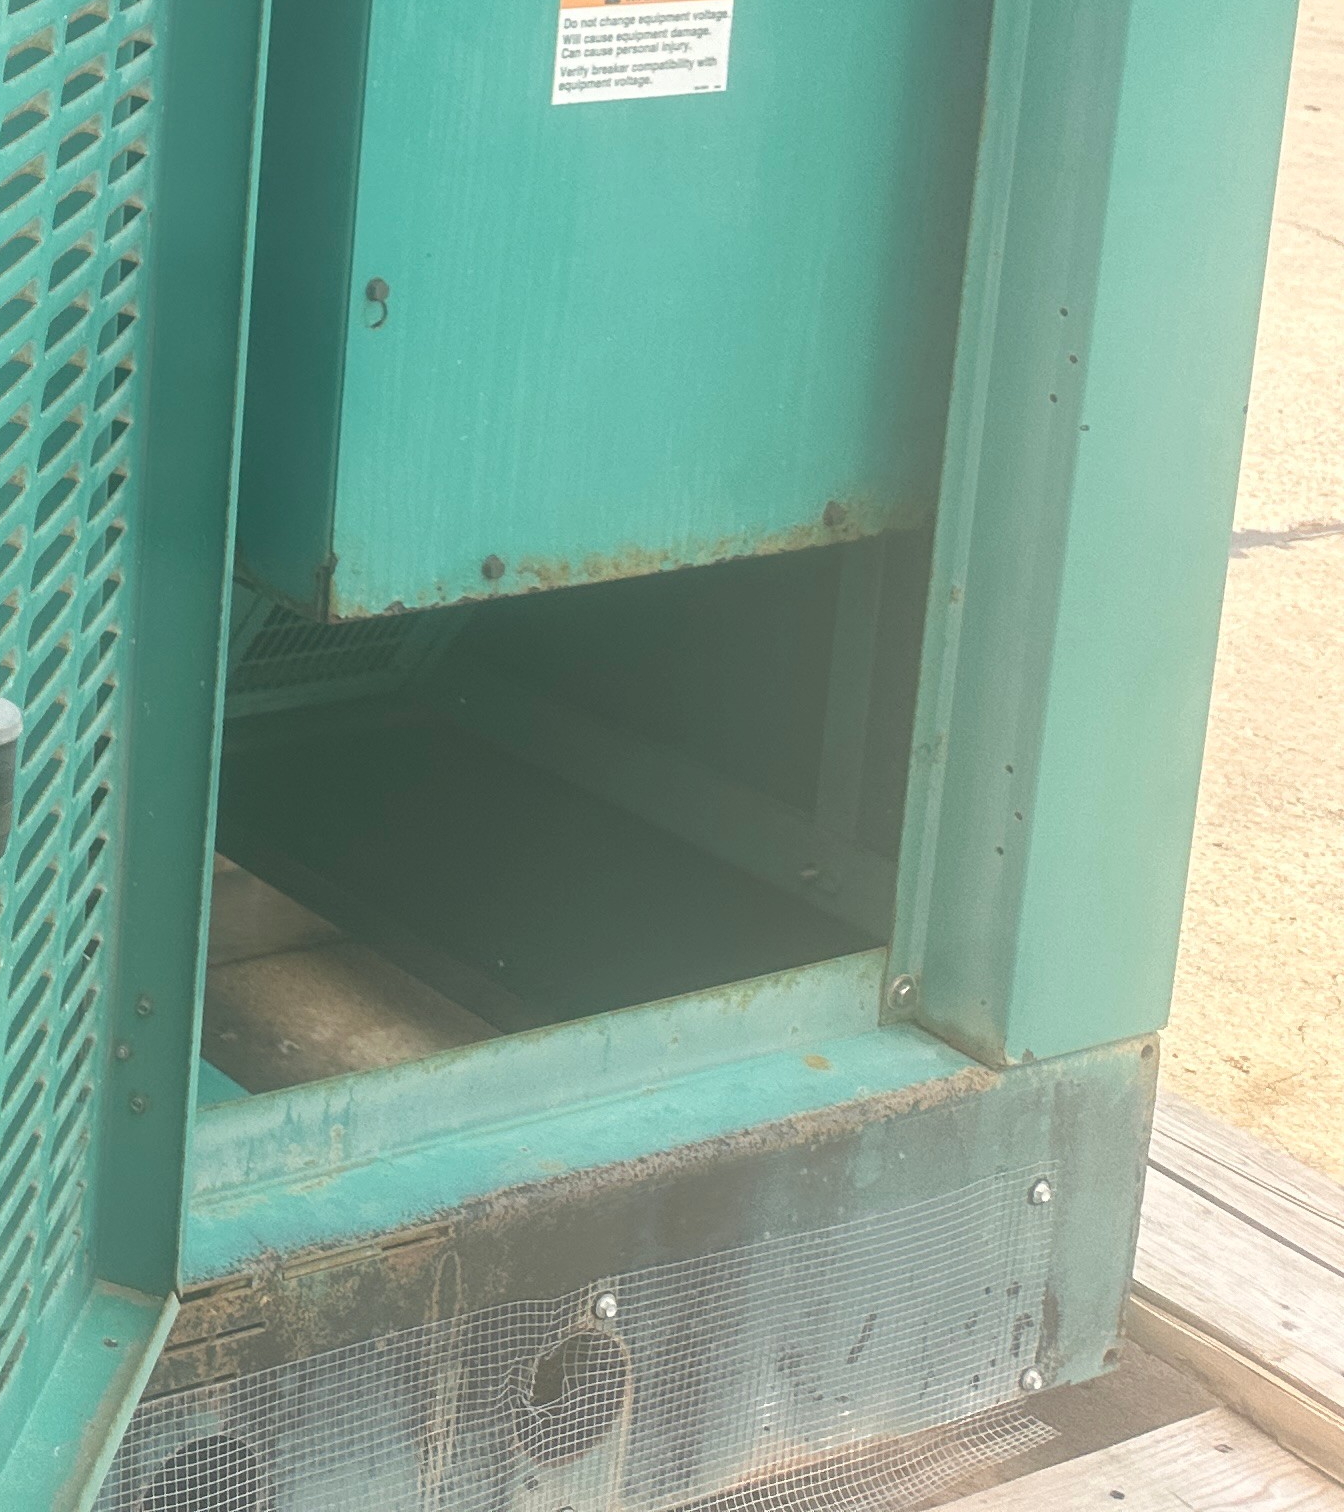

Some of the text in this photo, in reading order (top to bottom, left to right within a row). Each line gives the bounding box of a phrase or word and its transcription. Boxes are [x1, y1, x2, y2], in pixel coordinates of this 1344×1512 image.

[564, 18, 578, 29] Do
[581, 17, 597, 28] not
[600, 16, 636, 28] change
[638, 12, 691, 26] equipment
[563, 34, 582, 44] Will
[584, 34, 613, 44] cause
[616, 29, 669, 42] equipment
[562, 48, 581, 58] Can
[584, 48, 613, 57] cause
[616, 42, 659, 57] personal
[560, 56, 717, 78] Verify breaker compatibility with
[558, 78, 612, 92] equipment
